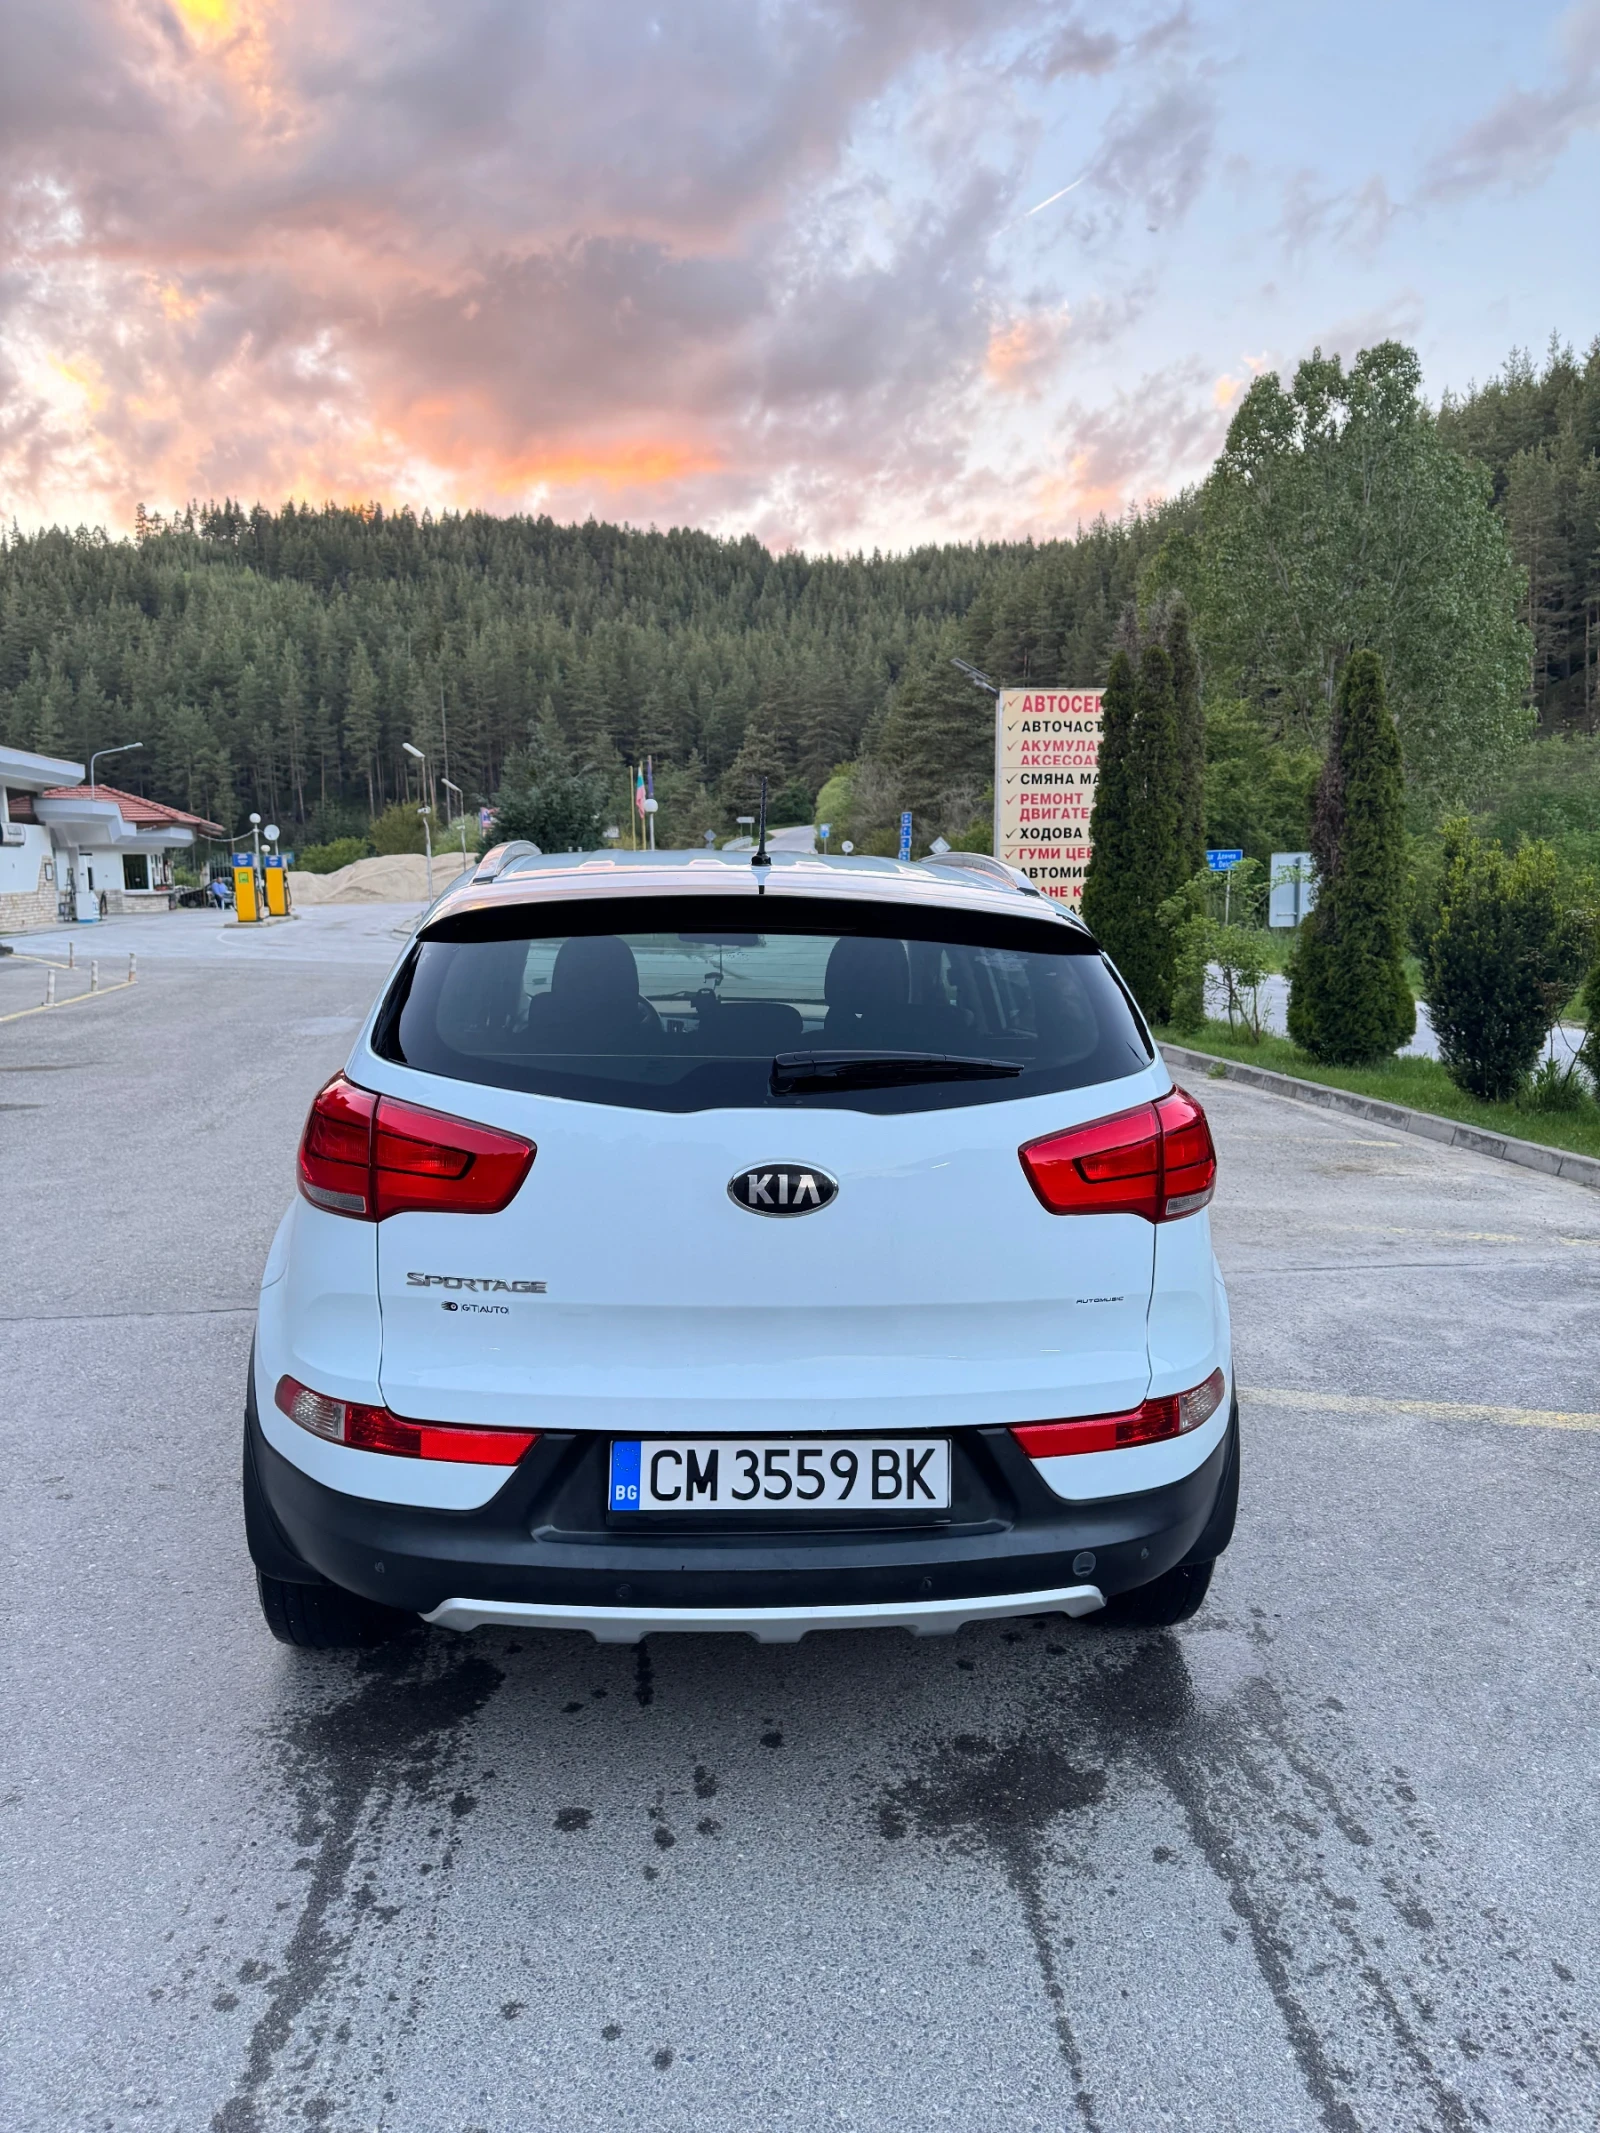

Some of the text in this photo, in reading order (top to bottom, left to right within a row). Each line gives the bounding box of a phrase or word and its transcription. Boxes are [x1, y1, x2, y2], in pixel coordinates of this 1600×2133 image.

[1021, 740, 1103, 752] АКУМУЛА
[1020, 773, 1074, 785] СМЯНА
[1020, 792, 1083, 805] РЕМОНТ
[1020, 827, 1082, 841] ХОДОВА
[1019, 848, 1060, 860] ГУМИ
[747, 1174, 821, 1204] KIA
[405, 1271, 548, 1294] SPORTAGE
[650, 1448, 936, 1502] CM 3559 BK
[615, 1485, 638, 1501] BG
